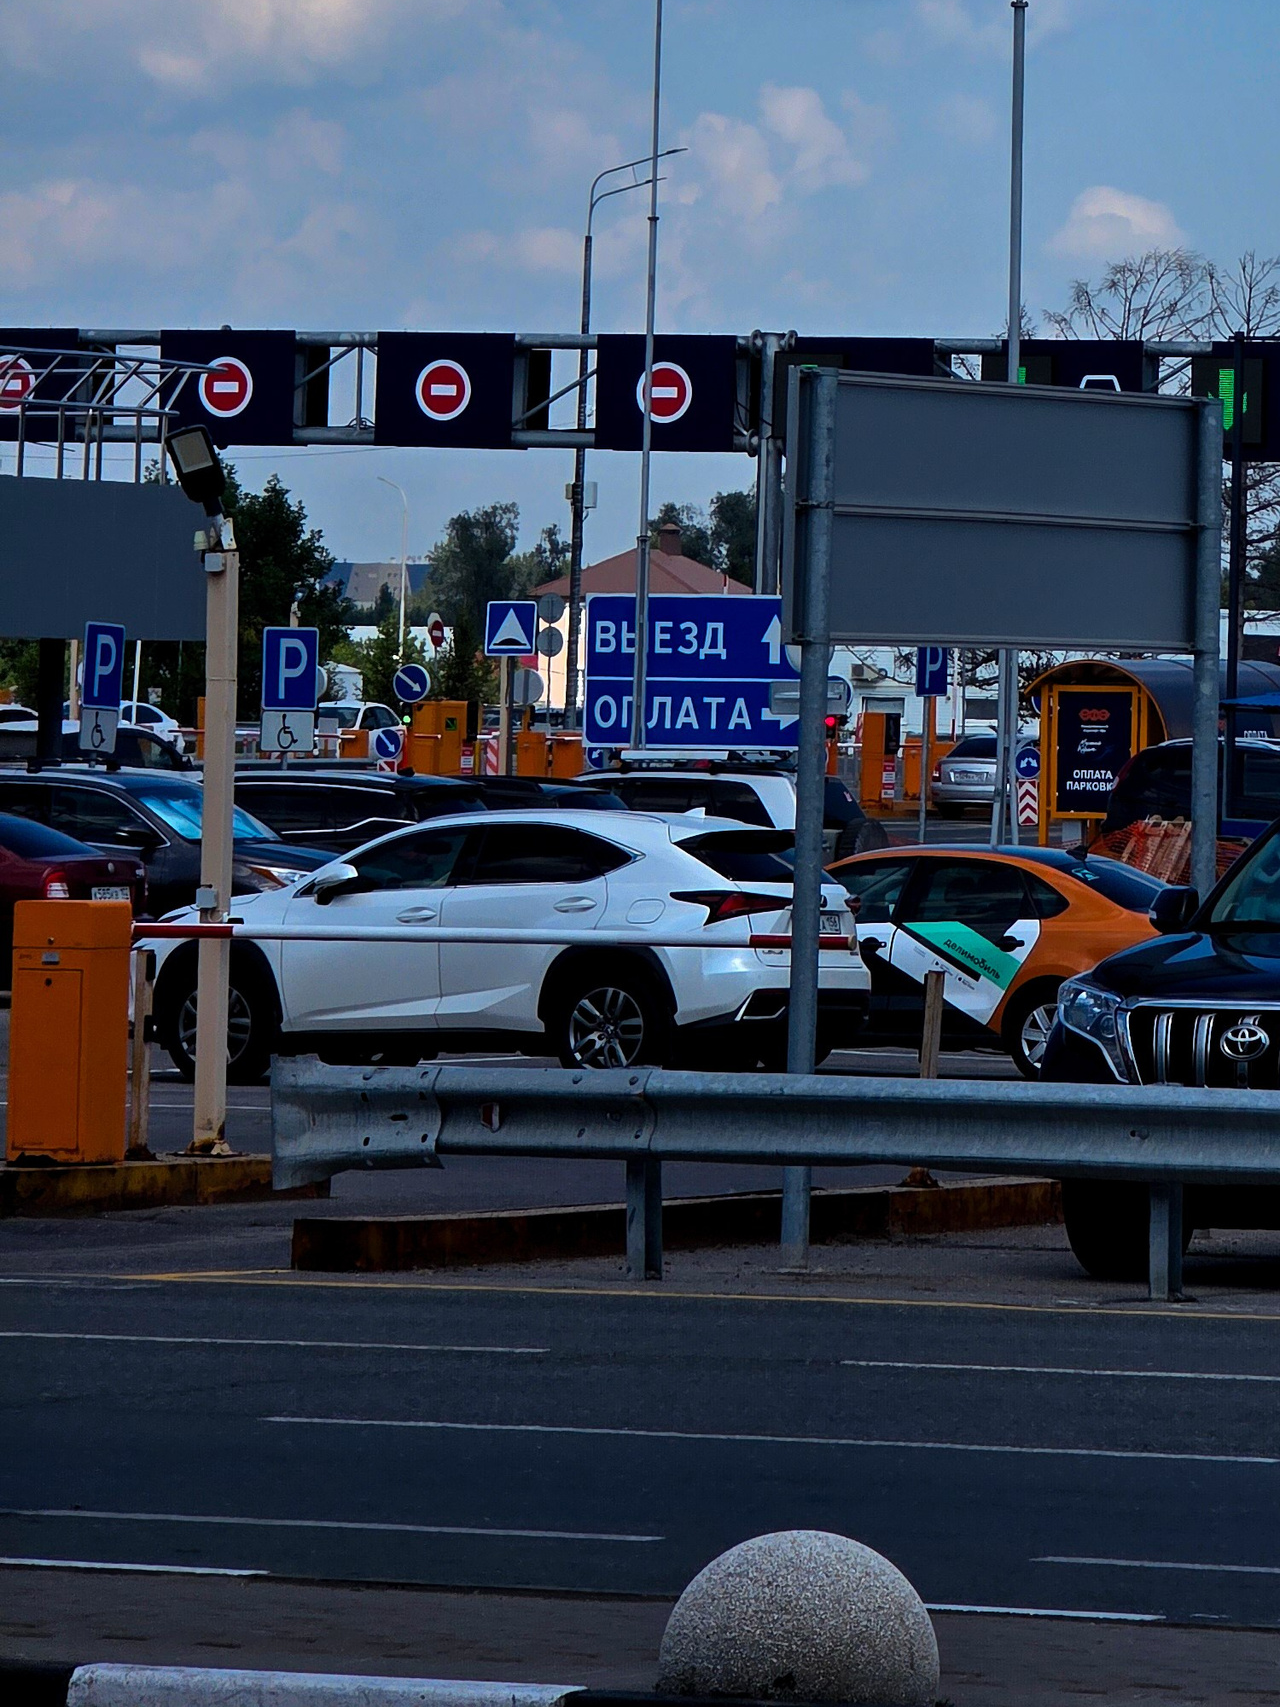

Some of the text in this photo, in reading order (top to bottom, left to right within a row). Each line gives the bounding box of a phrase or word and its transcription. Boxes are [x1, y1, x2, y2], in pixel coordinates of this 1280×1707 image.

[595, 621, 727, 660] ВЫЕЗД
[93, 634, 117, 698] P
[278, 638, 308, 700] P
[594, 695, 752, 730] ОПЛАТА
[1066, 781, 1113, 792] ПАРКОВК
[1073, 769, 1113, 780] ОПЛАТА
[943, 939, 1001, 981] делимобиль
